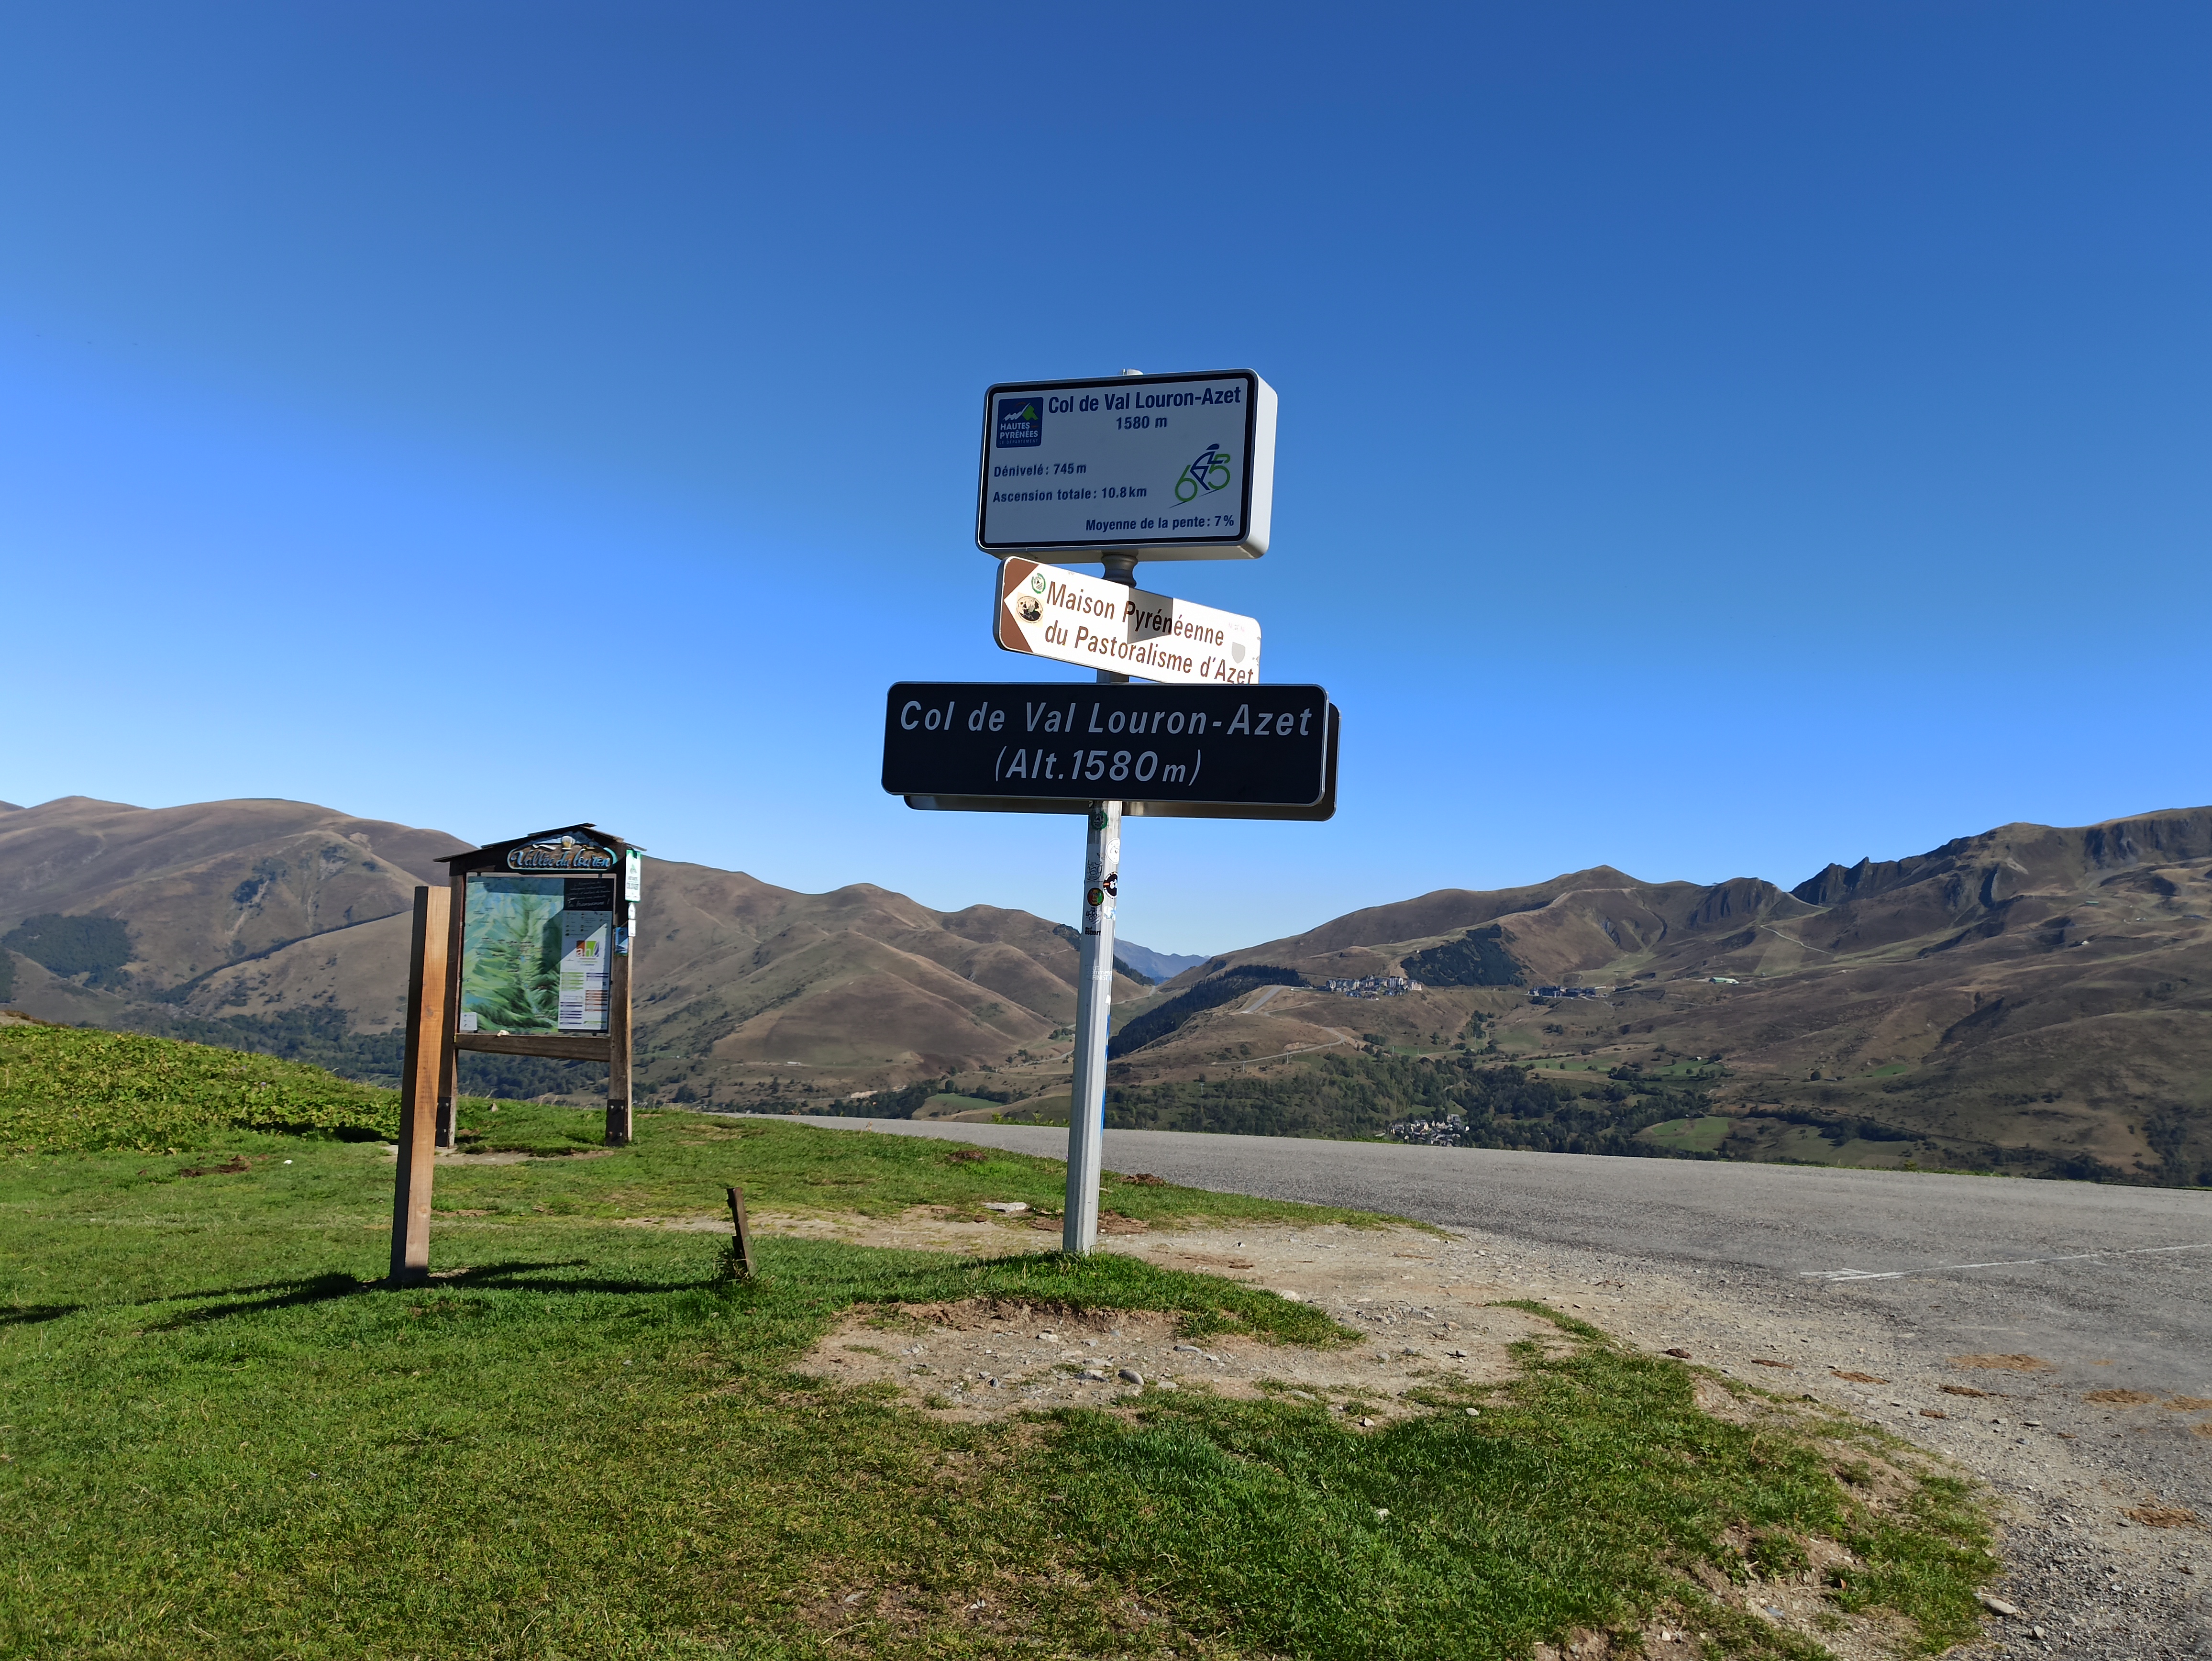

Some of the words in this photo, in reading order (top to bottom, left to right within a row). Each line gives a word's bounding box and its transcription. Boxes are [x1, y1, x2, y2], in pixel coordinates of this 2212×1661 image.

[1049, 396, 1074, 413] Col
[1079, 395, 1099, 412] de
[1105, 393, 1130, 410] Val
[1136, 387, 1241, 409] Louron-Azet
[1116, 416, 1150, 430] 1580
[1155, 417, 1167, 428] m
[1000, 429, 1038, 439] PYRÉNÉES
[993, 489, 1052, 502] Ascension
[1085, 519, 1137, 533] Moyenne
[1140, 518, 1154, 529] de
[1158, 517, 1168, 528] la
[1046, 581, 1115, 620] Maison
[1123, 600, 1224, 646] Pyrénéenne
[1045, 620, 1067, 646] du
[1074, 626, 1193, 674] Pastoralisme
[1200, 656, 1253, 684] d'Azet
[900, 701, 955, 731] Col
[968, 702, 1005, 732] de
[1026, 702, 1075, 733] Val
[1088, 702, 1312, 736] Louron-Azet
